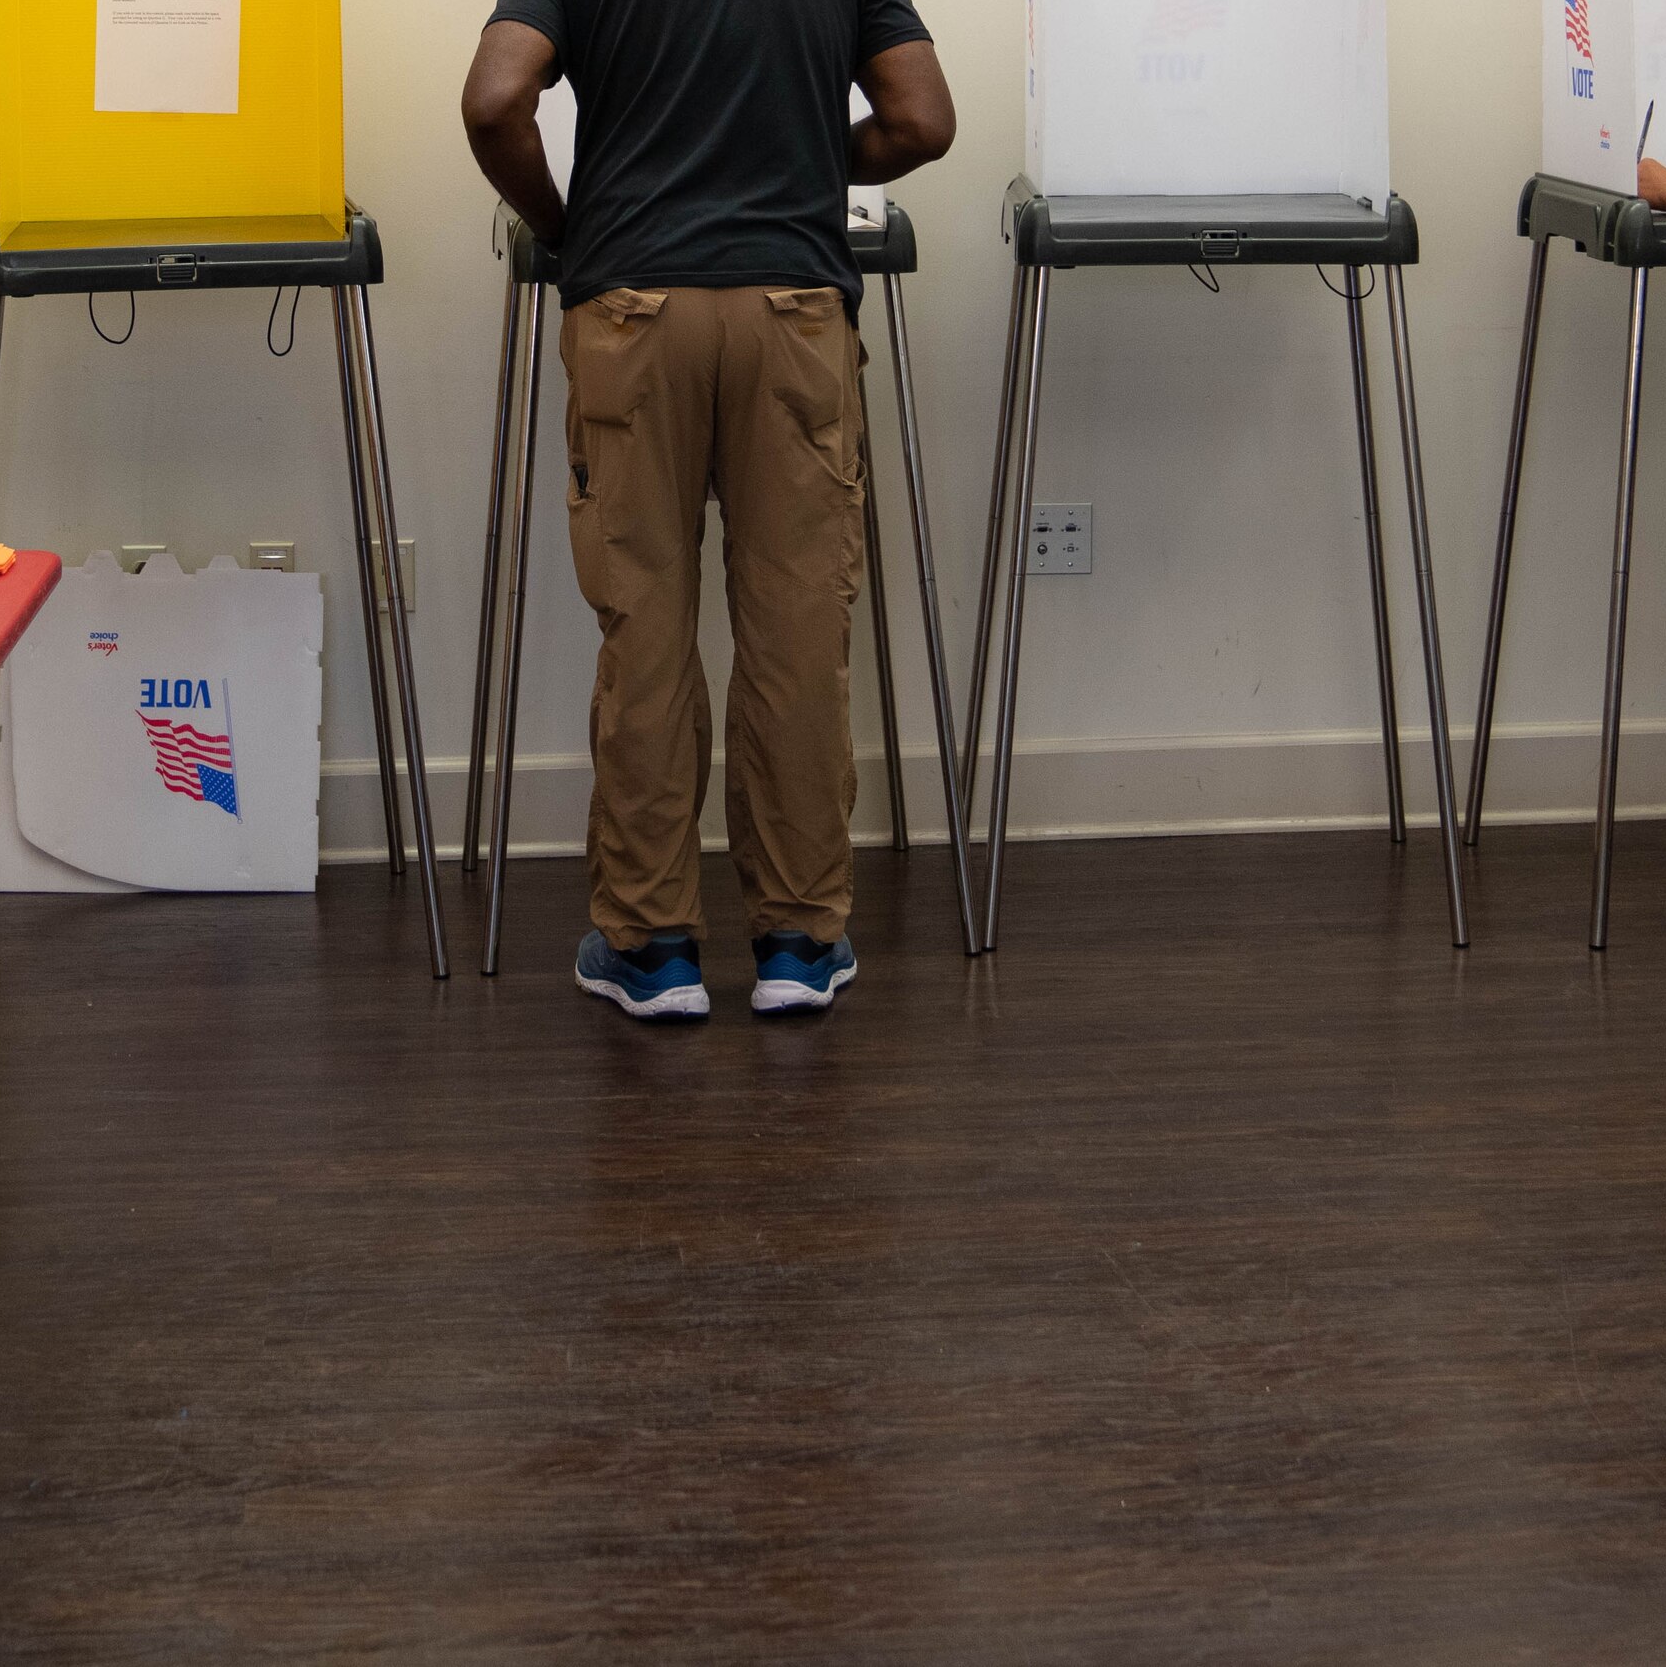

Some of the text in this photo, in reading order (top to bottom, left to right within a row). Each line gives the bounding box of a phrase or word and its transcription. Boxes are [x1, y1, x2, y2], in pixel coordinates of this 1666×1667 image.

[1572, 67, 1594, 99] VOTE
[90, 632, 119, 641] choice
[87, 642, 118, 657] Voter's
[140, 679, 212, 708] VOTE
